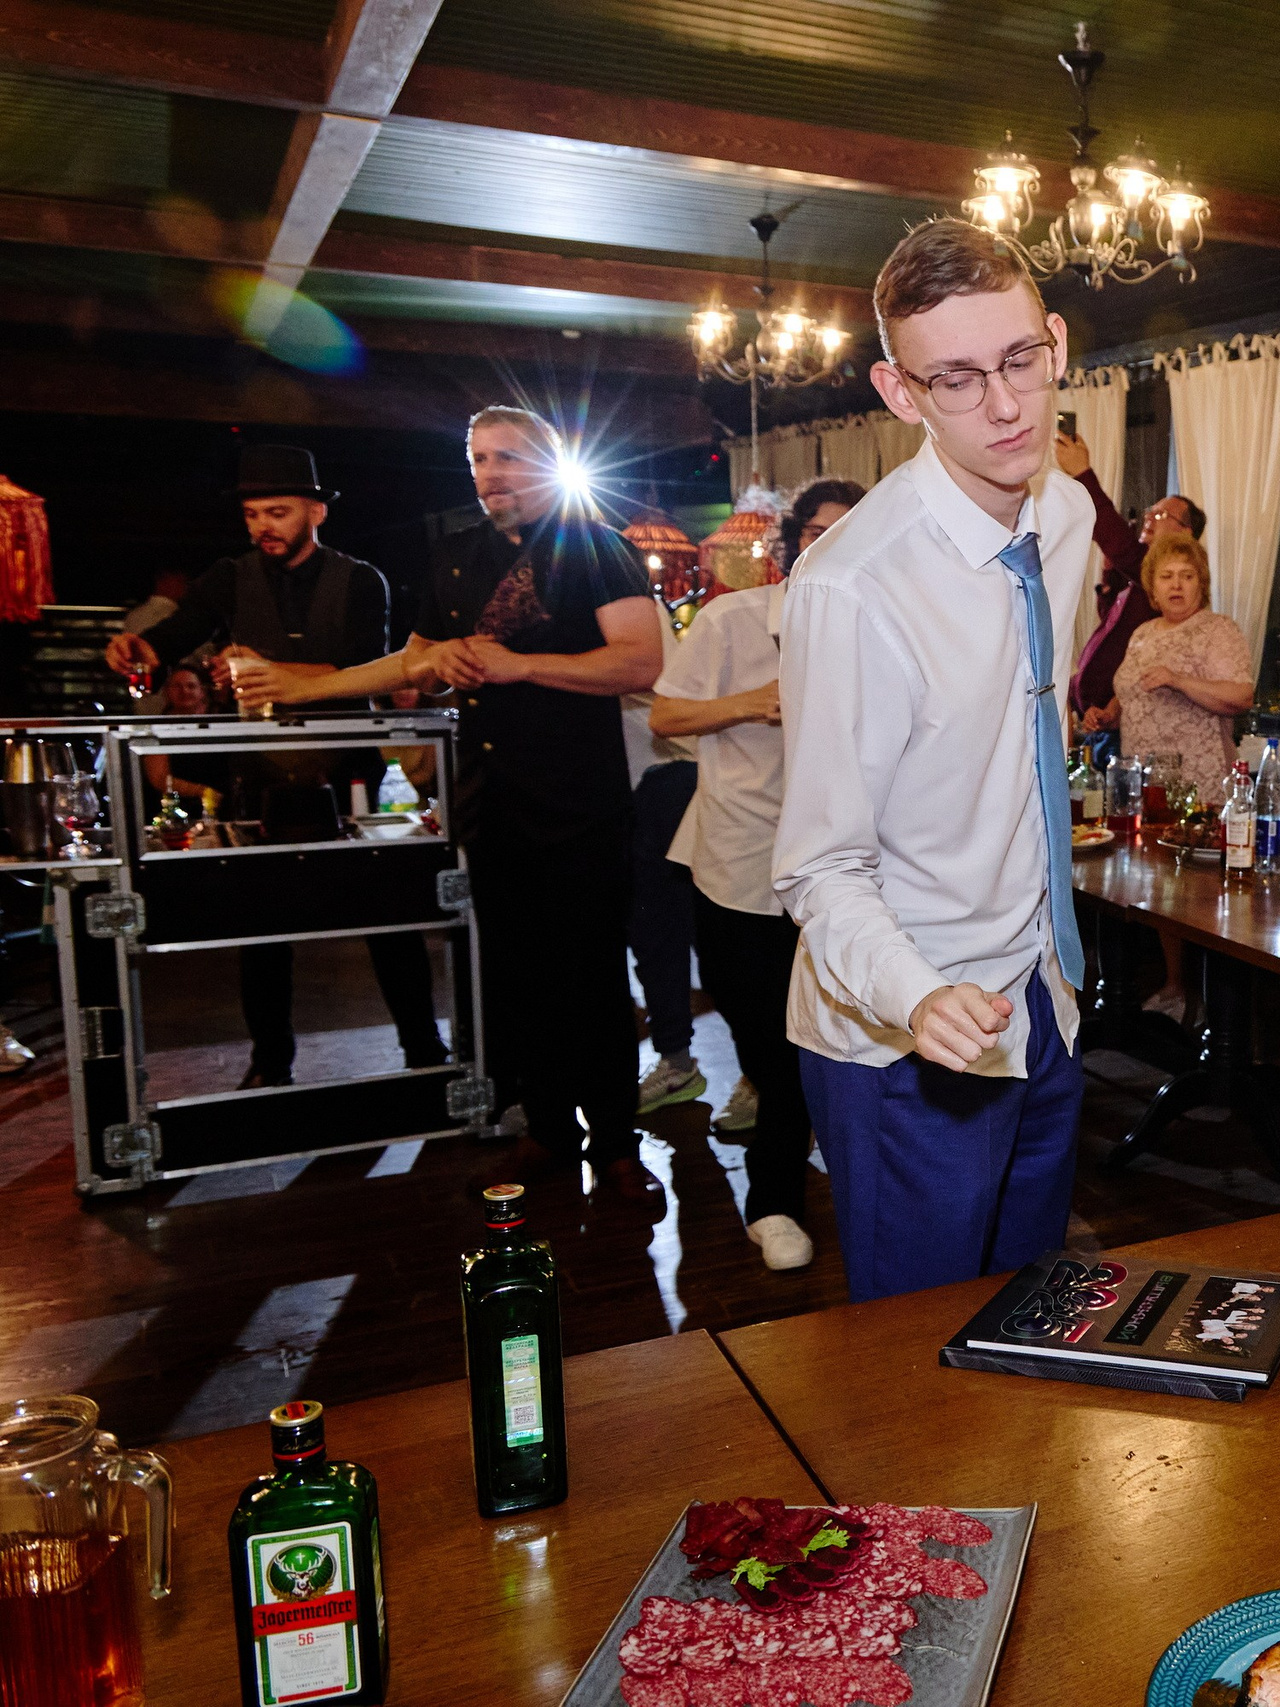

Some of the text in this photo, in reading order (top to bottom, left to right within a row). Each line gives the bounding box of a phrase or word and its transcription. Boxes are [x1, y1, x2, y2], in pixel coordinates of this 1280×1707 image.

[1000, 1259, 1129, 1344] 2025
[1116, 1275, 1173, 1340] ВЫПУСКНОЙ
[298, 1632, 315, 1647] 56
